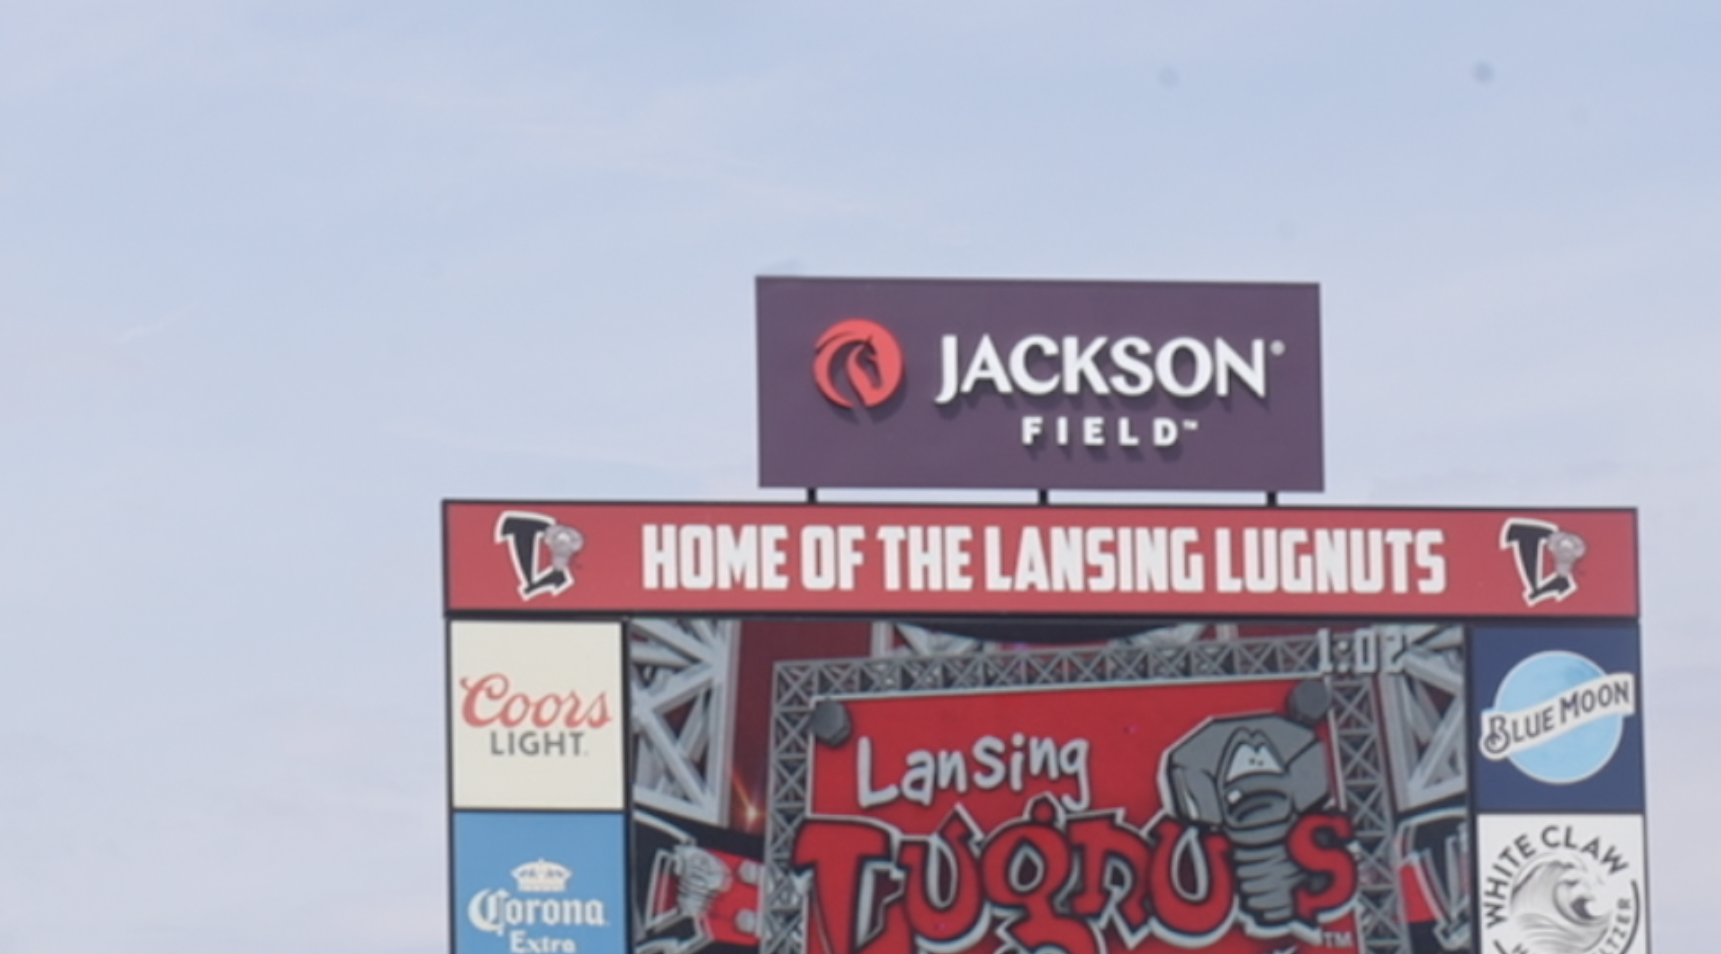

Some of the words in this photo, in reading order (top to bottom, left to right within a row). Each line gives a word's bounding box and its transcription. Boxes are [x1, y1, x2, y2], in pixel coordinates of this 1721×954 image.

[935, 334, 1266, 403] JACKSON
[1022, 415, 1178, 446] FIELD
[642, 524, 789, 591] HOME
[801, 525, 865, 591] OF
[876, 525, 973, 591] THE
[984, 526, 1204, 593] LANSING
[1215, 527, 1446, 594] LUGNUTS
[460, 673, 612, 729] Coors
[1483, 706, 1556, 755] BLUE
[1559, 680, 1631, 725] MOON
[490, 732, 584, 757] LIGHT
[857, 733, 1091, 811] Lansing
[1483, 833, 1536, 929] WHITE
[1540, 825, 1629, 876] CLAW
[468, 887, 606, 937] Corona
[509, 930, 576, 954] Extra
